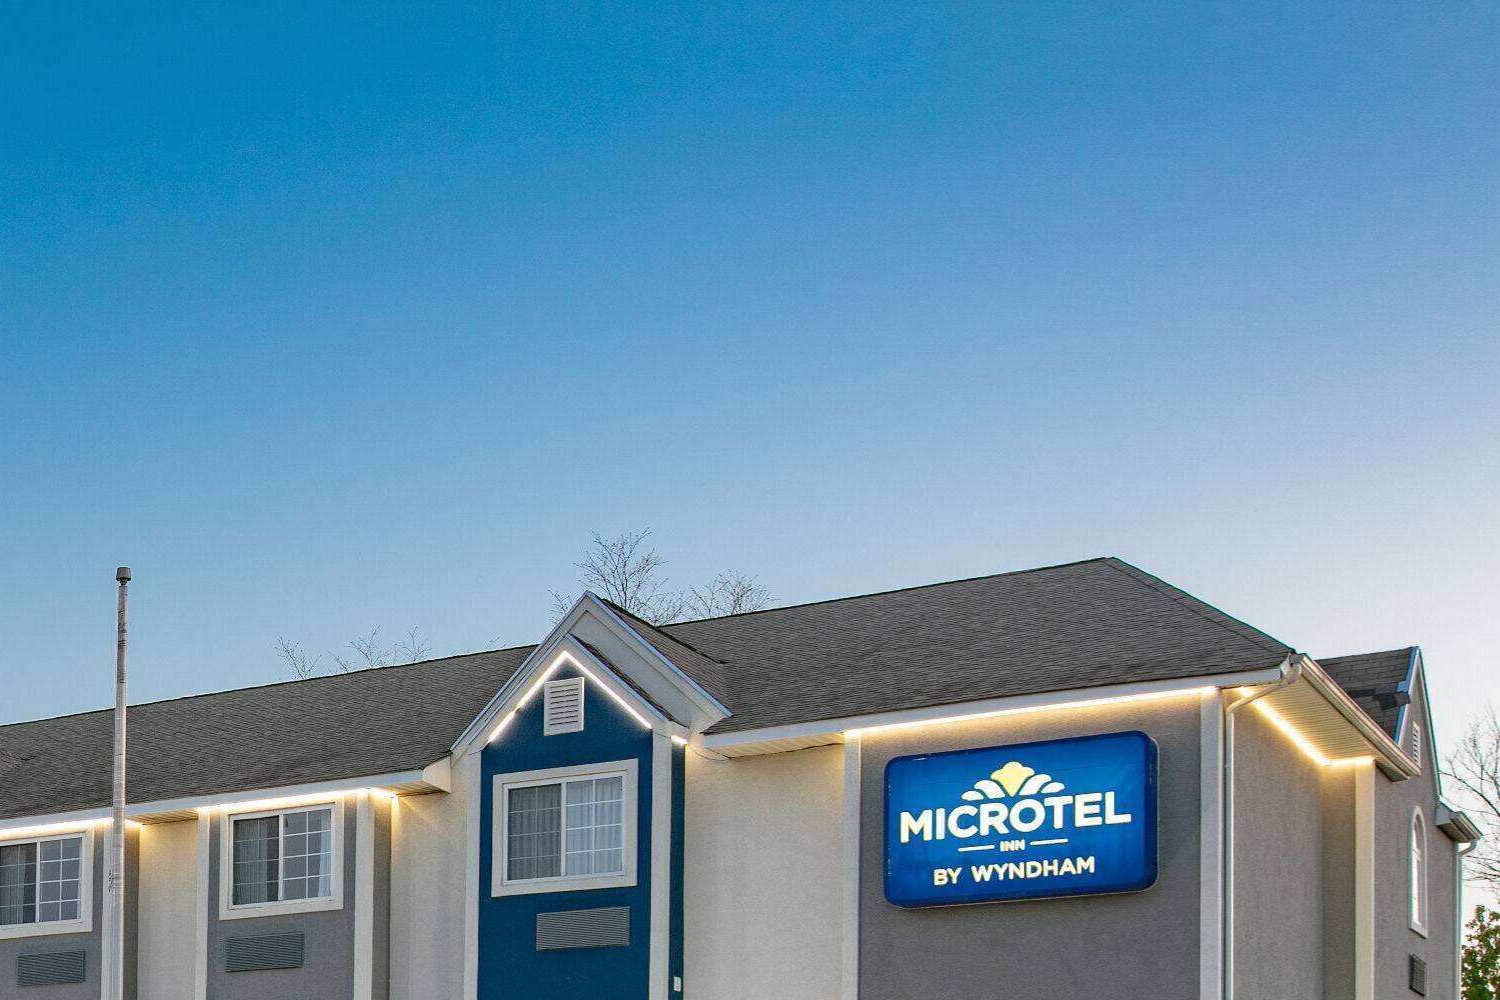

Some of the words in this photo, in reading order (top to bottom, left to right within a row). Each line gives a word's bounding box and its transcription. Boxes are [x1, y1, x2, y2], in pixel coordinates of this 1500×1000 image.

[900, 791, 1132, 843] MICROTEL
[1000, 839, 1025, 851] INN
[933, 867, 963, 886] BY
[972, 856, 1095, 883] WYNDHAM
